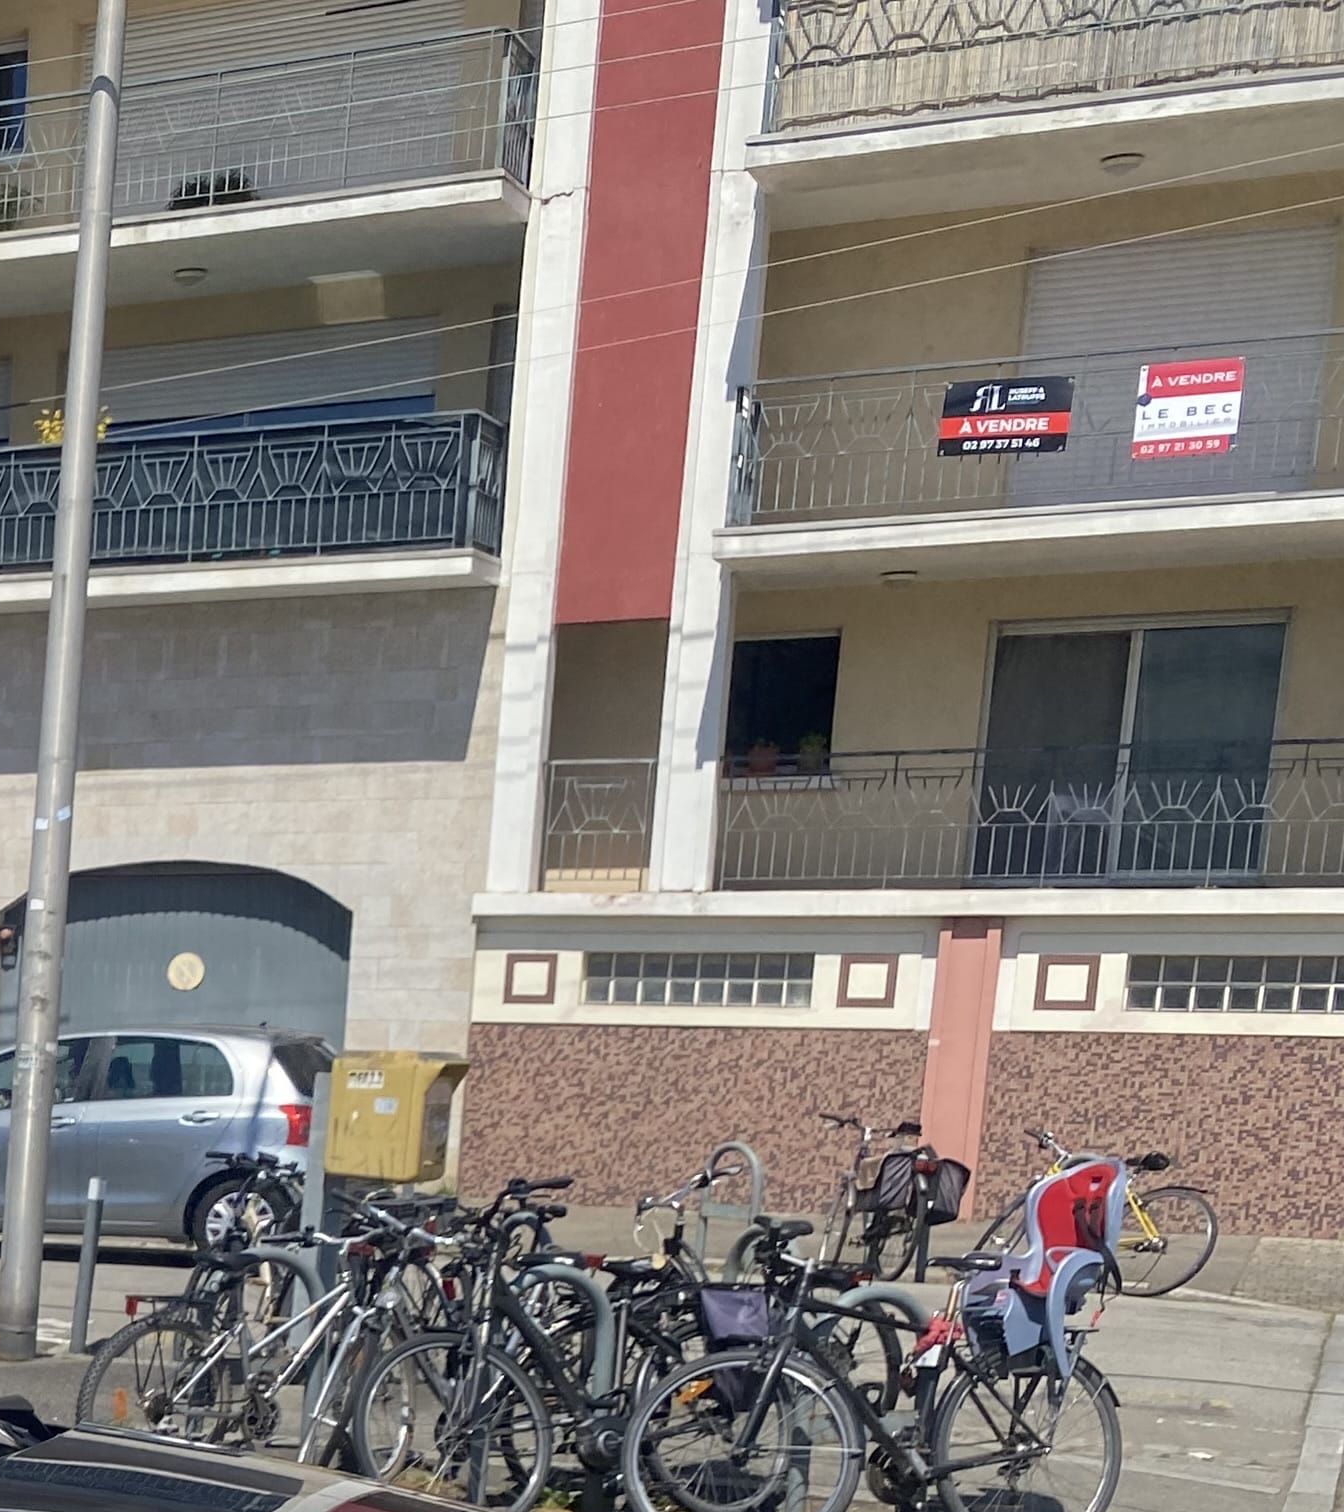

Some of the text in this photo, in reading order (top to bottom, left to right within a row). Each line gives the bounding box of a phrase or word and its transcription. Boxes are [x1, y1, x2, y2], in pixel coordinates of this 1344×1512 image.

[1167, 371, 1237, 387] VENDRE
[1142, 403, 1233, 420] LE BEC
[959, 417, 1050, 434] À VENDRE
[962, 440, 977, 451] 02
[979, 440, 993, 450] 97
[995, 439, 1009, 449] 37
[1011, 438, 1023, 448] 51
[1140, 444, 1155, 454] 02
[1174, 442, 1185, 452] 21
[1189, 440, 1203, 450] 30
[1206, 439, 1221, 449] 59
